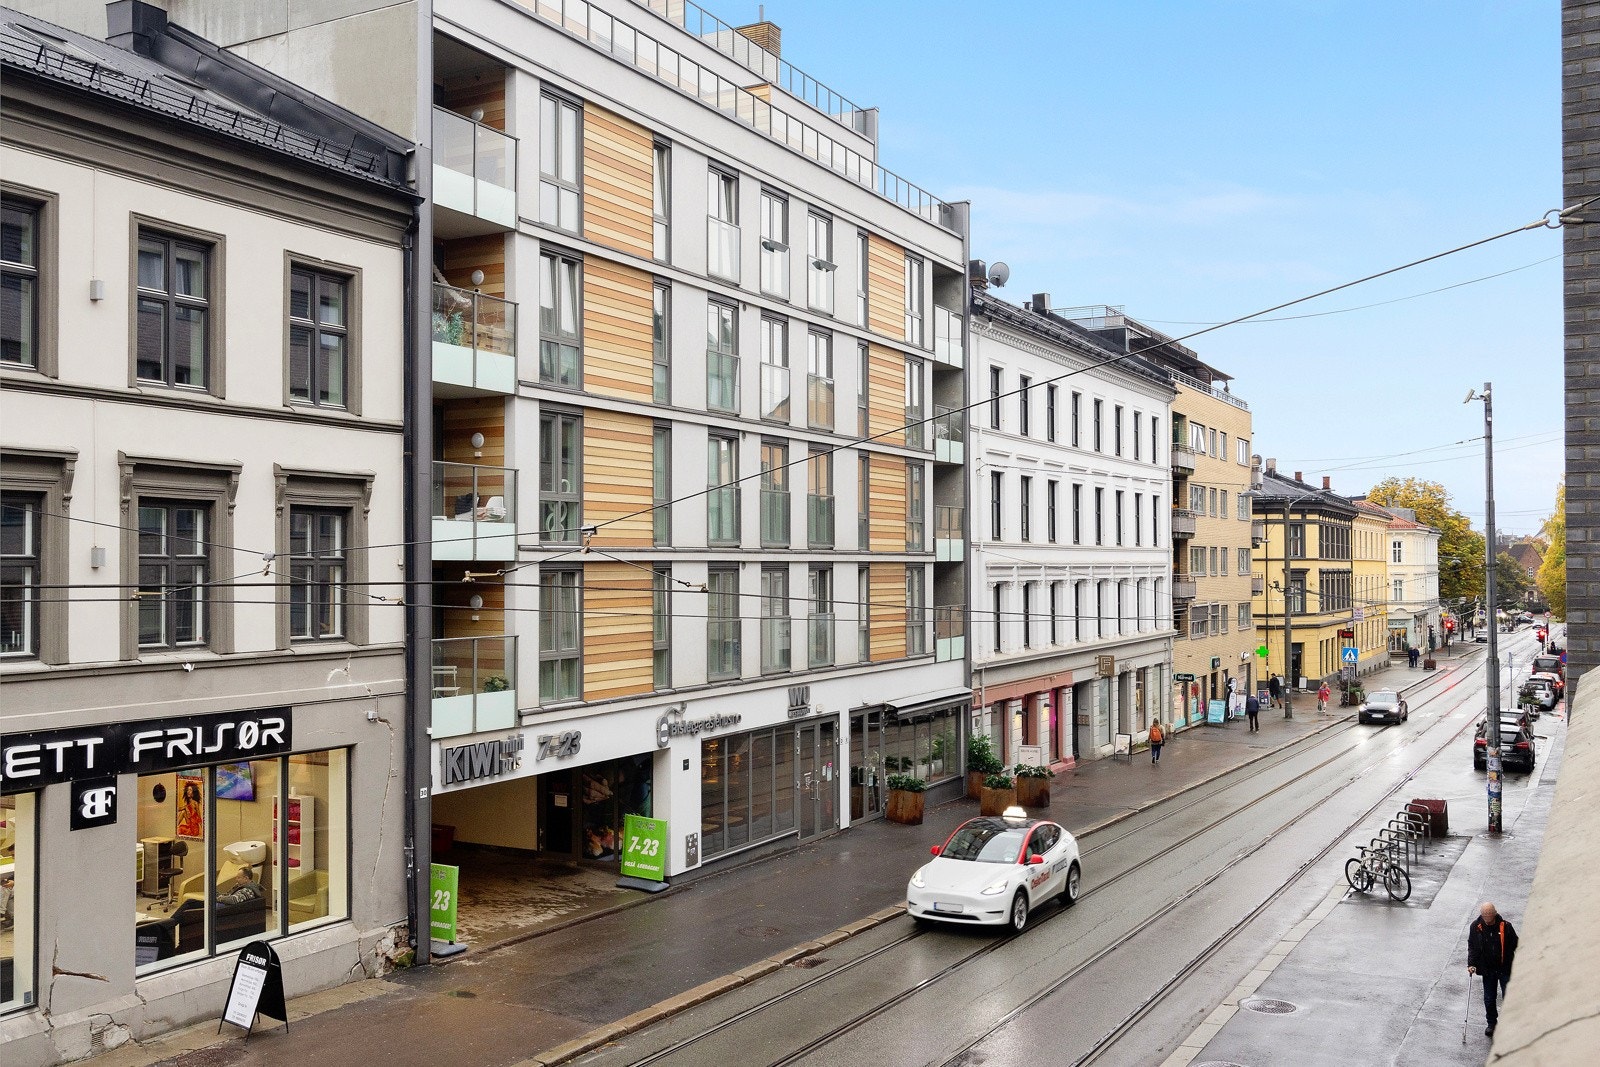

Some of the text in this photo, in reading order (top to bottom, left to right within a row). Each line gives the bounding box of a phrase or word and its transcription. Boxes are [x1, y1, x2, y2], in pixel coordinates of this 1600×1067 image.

[0, 717, 285, 780] ETT FRISØR
[536, 731, 582, 762] 7-23
[443, 741, 501, 785] KIWI
[501, 757, 522, 775] pris
[627, 836, 660, 857] 7-23
[246, 953, 267, 967] FRISØR
